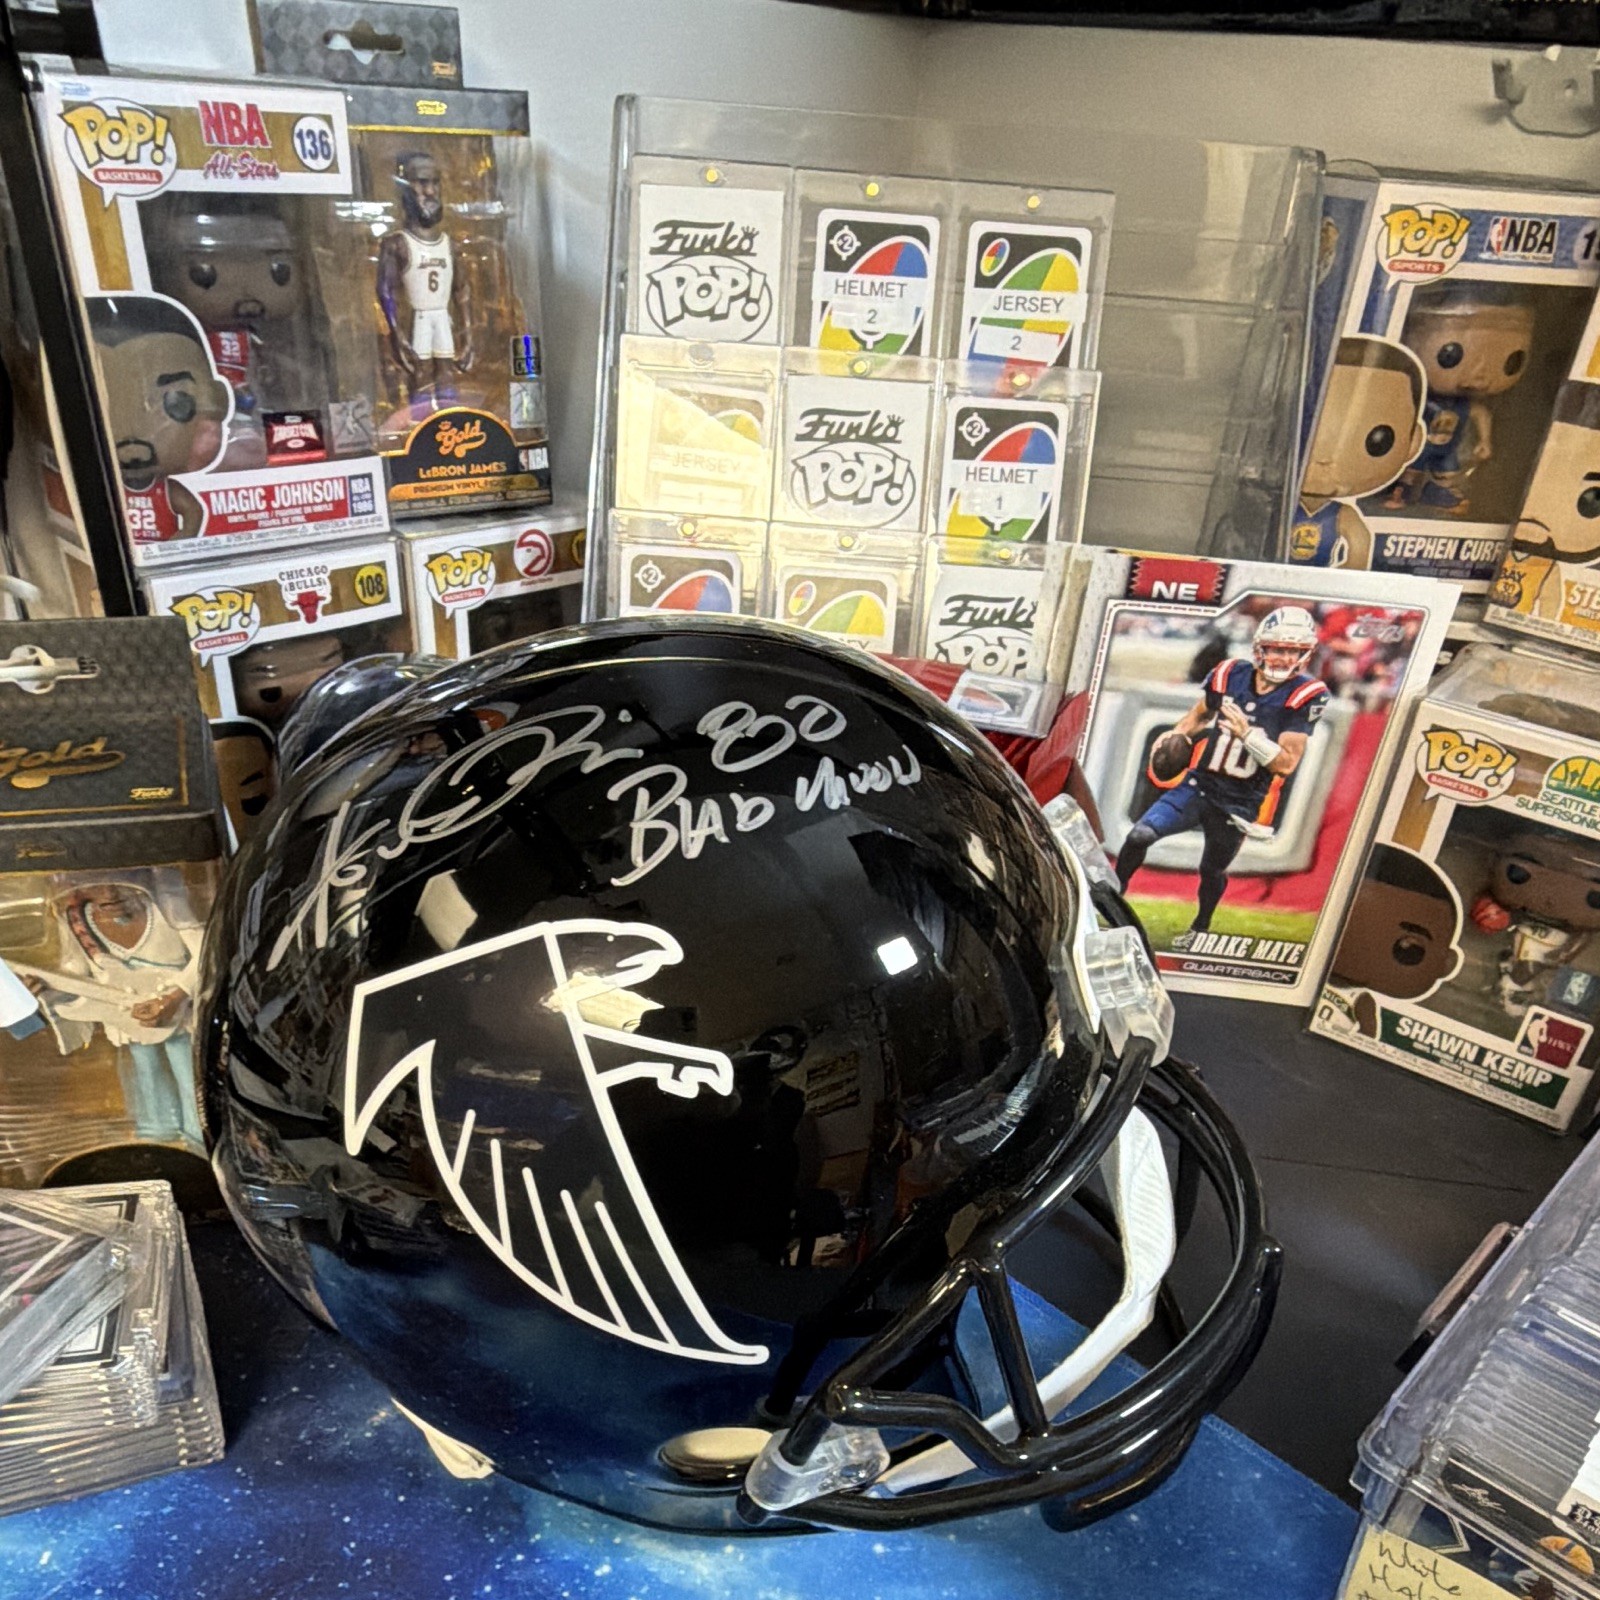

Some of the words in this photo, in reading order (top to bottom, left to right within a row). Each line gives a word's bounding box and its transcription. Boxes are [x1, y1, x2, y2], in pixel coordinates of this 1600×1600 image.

[59, 103, 171, 167] POP!
[199, 100, 271, 148] NBA
[296, 129, 332, 160] 136
[98, 171, 159, 183] BASKETBALL
[650, 220, 760, 256] Funko
[1381, 208, 1471, 259] POP!
[1502, 219, 1558, 255] NBA
[1583, 229, 1600, 260] 1
[428, 271, 439, 293] 6
[647, 262, 766, 327] POP!
[834, 278, 908, 299] HELMET
[867, 308, 878, 324] 2
[993, 294, 1064, 315] JERSEY
[1011, 336, 1022, 351] 2
[795, 408, 903, 443] Funko
[469, 461, 508, 475] JAMES
[672, 451, 741, 474] JERSEY
[965, 466, 1038, 484] HELMET
[792, 449, 910, 508] POP!
[209, 486, 267, 516] MAGIC
[271, 477, 344, 509] JOHNSON
[127, 509, 157, 530] 32
[1383, 534, 1460, 561] STEPHEN
[278, 565, 328, 582] CHICAGO
[424, 549, 493, 595] POP!
[358, 575, 385, 599] 108
[1151, 581, 1200, 601] NE
[169, 591, 255, 639] POP!
[197, 633, 246, 649] BASKETBALL
[1422, 728, 1519, 788] POP!
[1539, 790, 1597, 816] SEATTLE
[1190, 932, 1253, 958] DRAKE
[1250, 938, 1306, 965] MAYE
[1182, 960, 1294, 982] QUARTERBACK
[1395, 1016, 1480, 1063] SHAWN
[1481, 1051, 1554, 1088] KEMP
